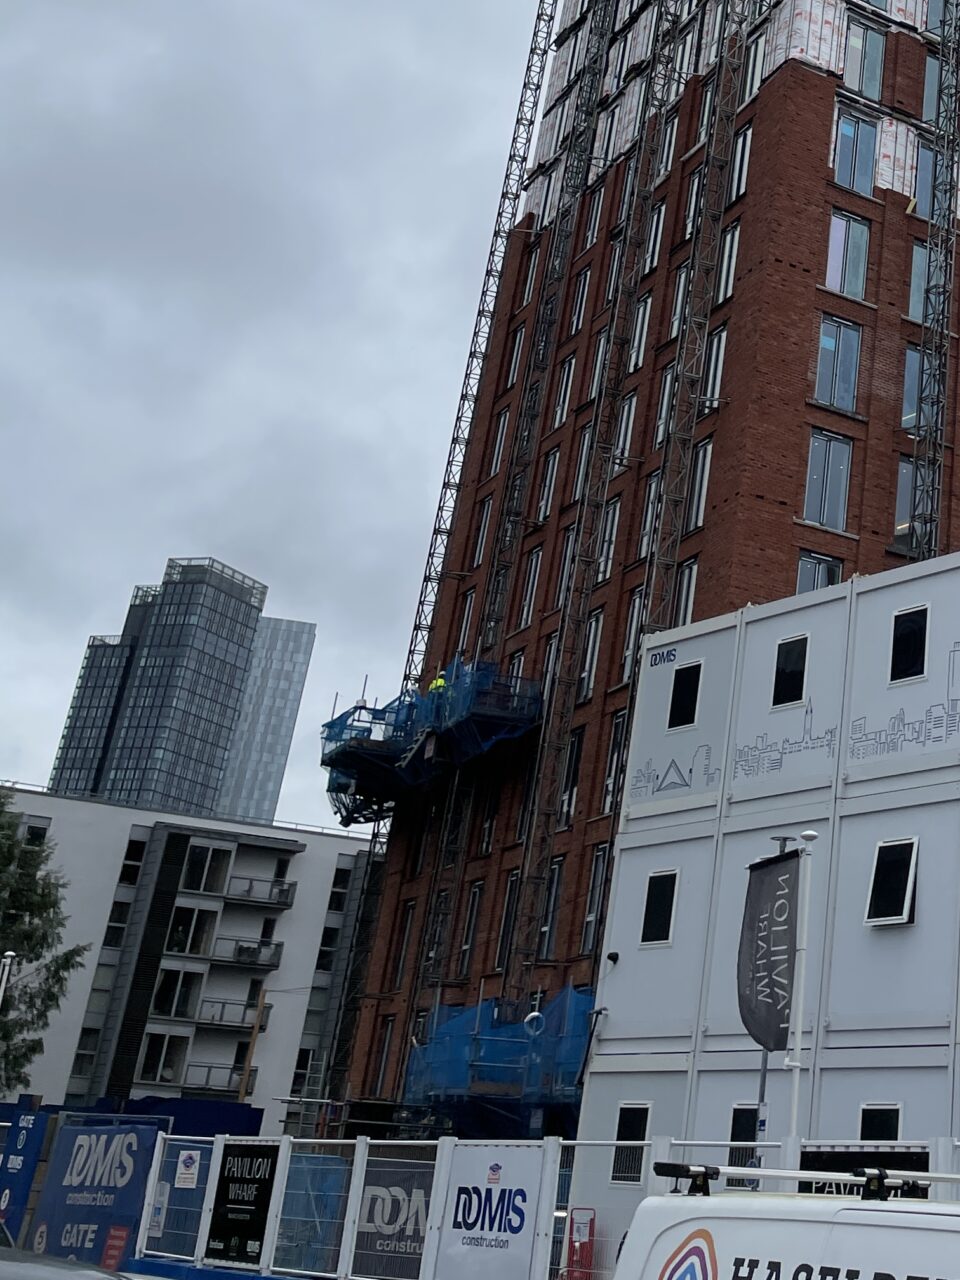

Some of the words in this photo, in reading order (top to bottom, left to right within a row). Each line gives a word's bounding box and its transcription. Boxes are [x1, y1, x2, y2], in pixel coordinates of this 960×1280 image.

[651, 649, 676, 667] DOMIS
[19, 1115, 34, 1128] GATE
[62, 1133, 137, 1188] DOMIS
[225, 1157, 271, 1179] PAVILION
[229, 1184, 259, 1201] WHARF
[452, 1186, 527, 1234] DOMIS
[61, 1224, 98, 1248] GATE
[461, 1235, 509, 1249] construction
